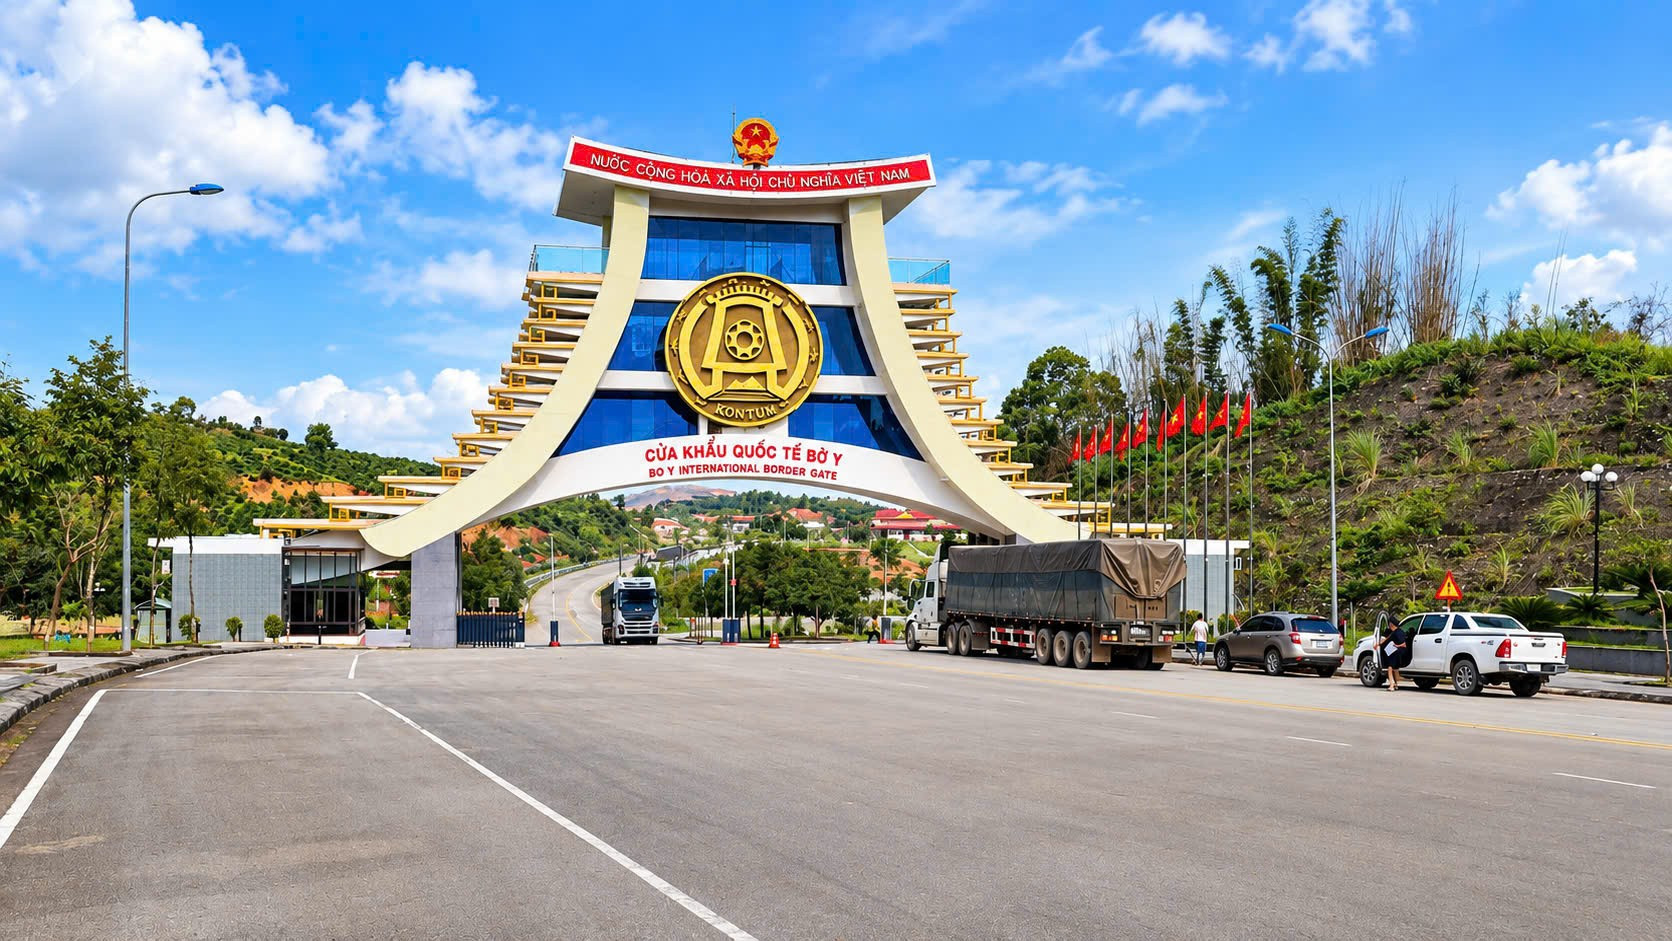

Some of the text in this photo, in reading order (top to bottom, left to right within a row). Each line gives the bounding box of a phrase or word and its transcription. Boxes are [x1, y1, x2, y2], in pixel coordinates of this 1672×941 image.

[845, 169, 874, 187] VIỆT
[880, 168, 910, 181] NAM
[715, 403, 777, 420] KONTUM
[682, 435, 727, 459] KHẨU
[733, 439, 777, 459] QUỐC
[782, 442, 802, 461] TẾ
[832, 452, 843, 466] Y
[649, 463, 837, 480] BO Y INTERNATIONAL BORDER GATE
